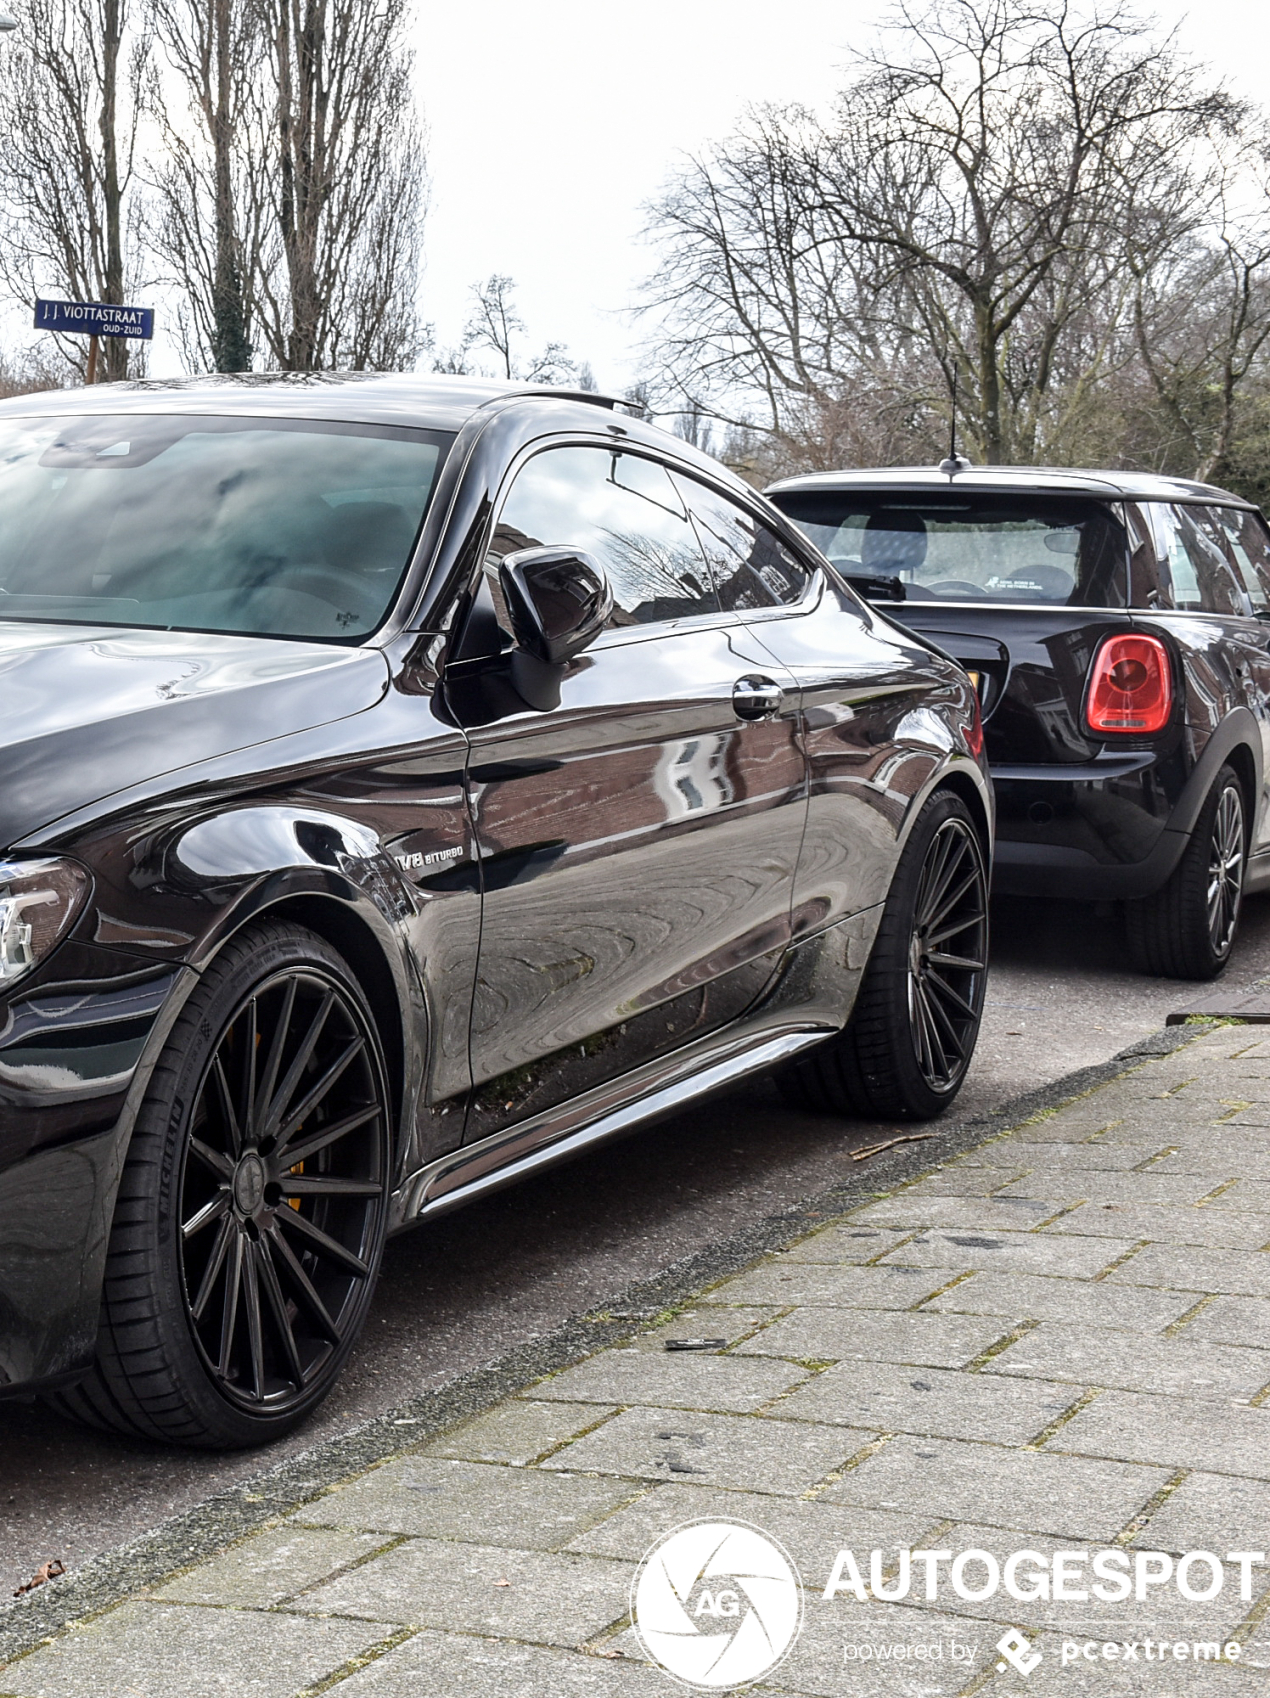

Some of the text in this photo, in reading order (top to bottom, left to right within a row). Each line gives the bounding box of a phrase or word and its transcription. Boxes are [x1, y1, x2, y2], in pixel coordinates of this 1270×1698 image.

[63, 305, 144, 324] VIOTTASTRAAT
[102, 323, 143, 335] OUD-ZUID
[394, 846, 464, 871] V8 BITURBO
[159, 1102, 183, 1214] MICHELIN
